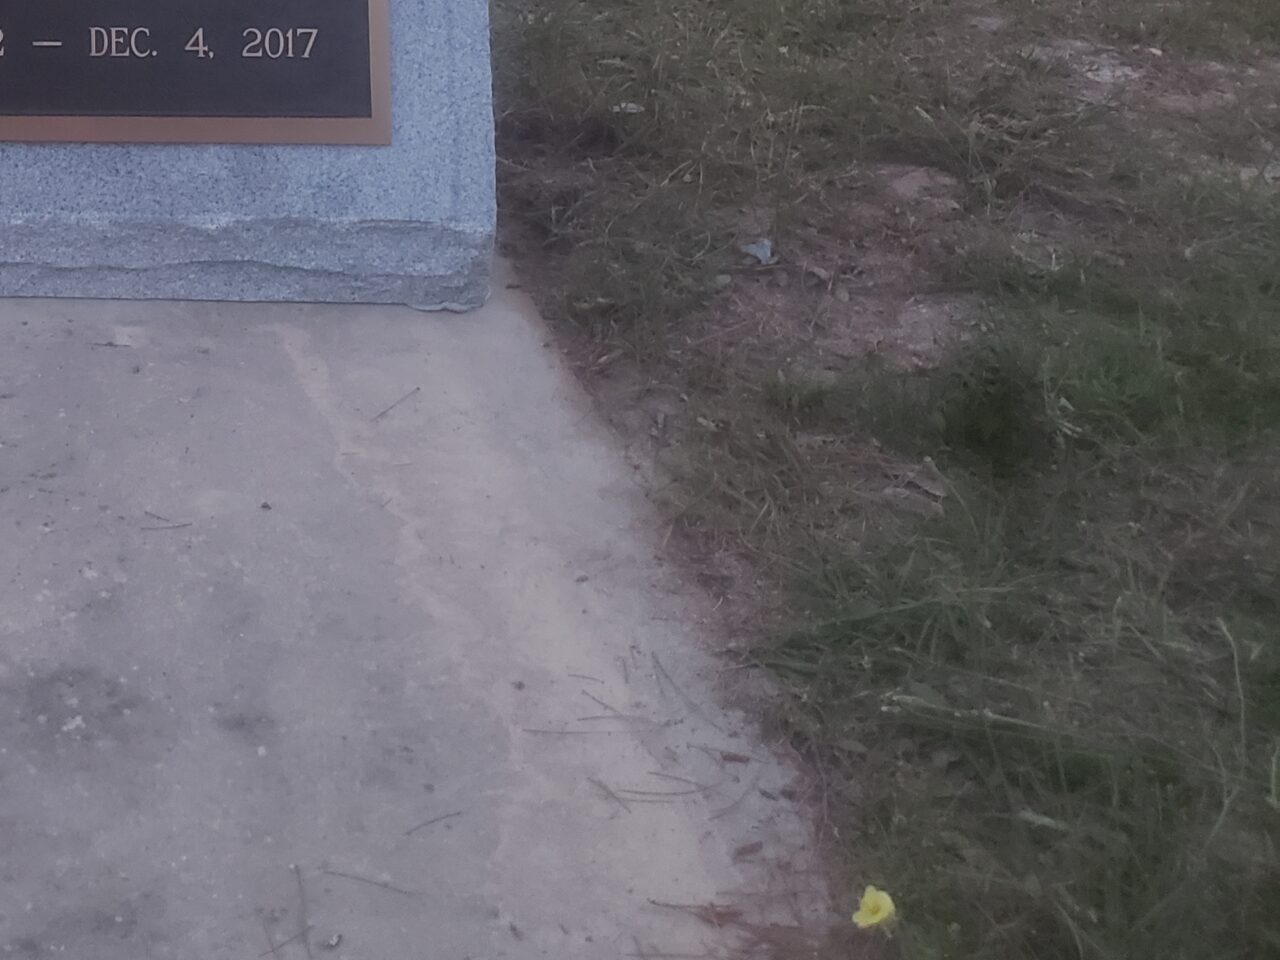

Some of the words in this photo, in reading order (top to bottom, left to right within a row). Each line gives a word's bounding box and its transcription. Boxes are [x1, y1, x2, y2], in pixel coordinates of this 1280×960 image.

[88, 26, 158, 58] DEC.
[184, 27, 215, 60] 4,
[242, 27, 319, 59] 2017
